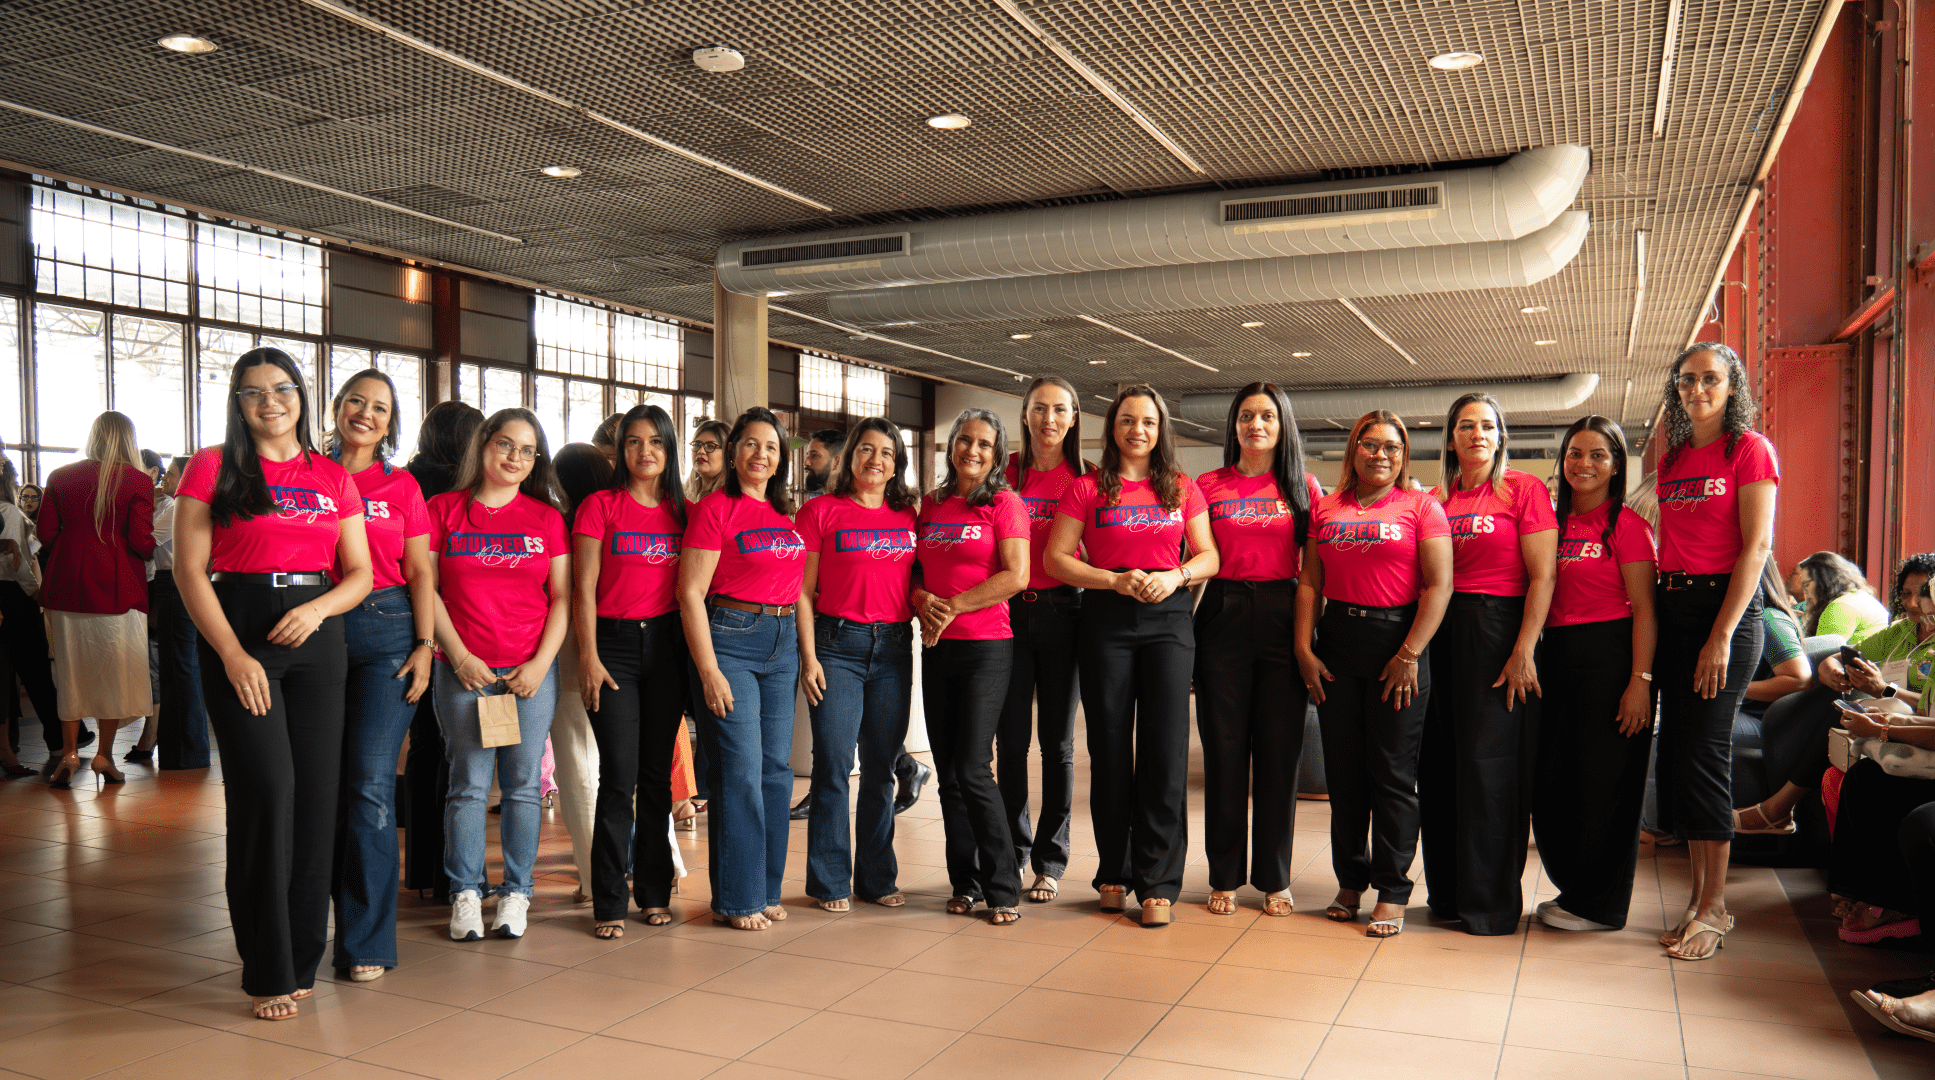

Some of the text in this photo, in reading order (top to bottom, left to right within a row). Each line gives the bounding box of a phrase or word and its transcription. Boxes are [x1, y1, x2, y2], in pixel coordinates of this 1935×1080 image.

[270, 489, 337, 512] LHERES
[1212, 500, 1291, 518] MULHERE
[450, 535, 544, 554] MULHERES
[617, 535, 682, 552] MULHE
[741, 530, 804, 550] MULHER
[841, 530, 917, 550] MULHERE
